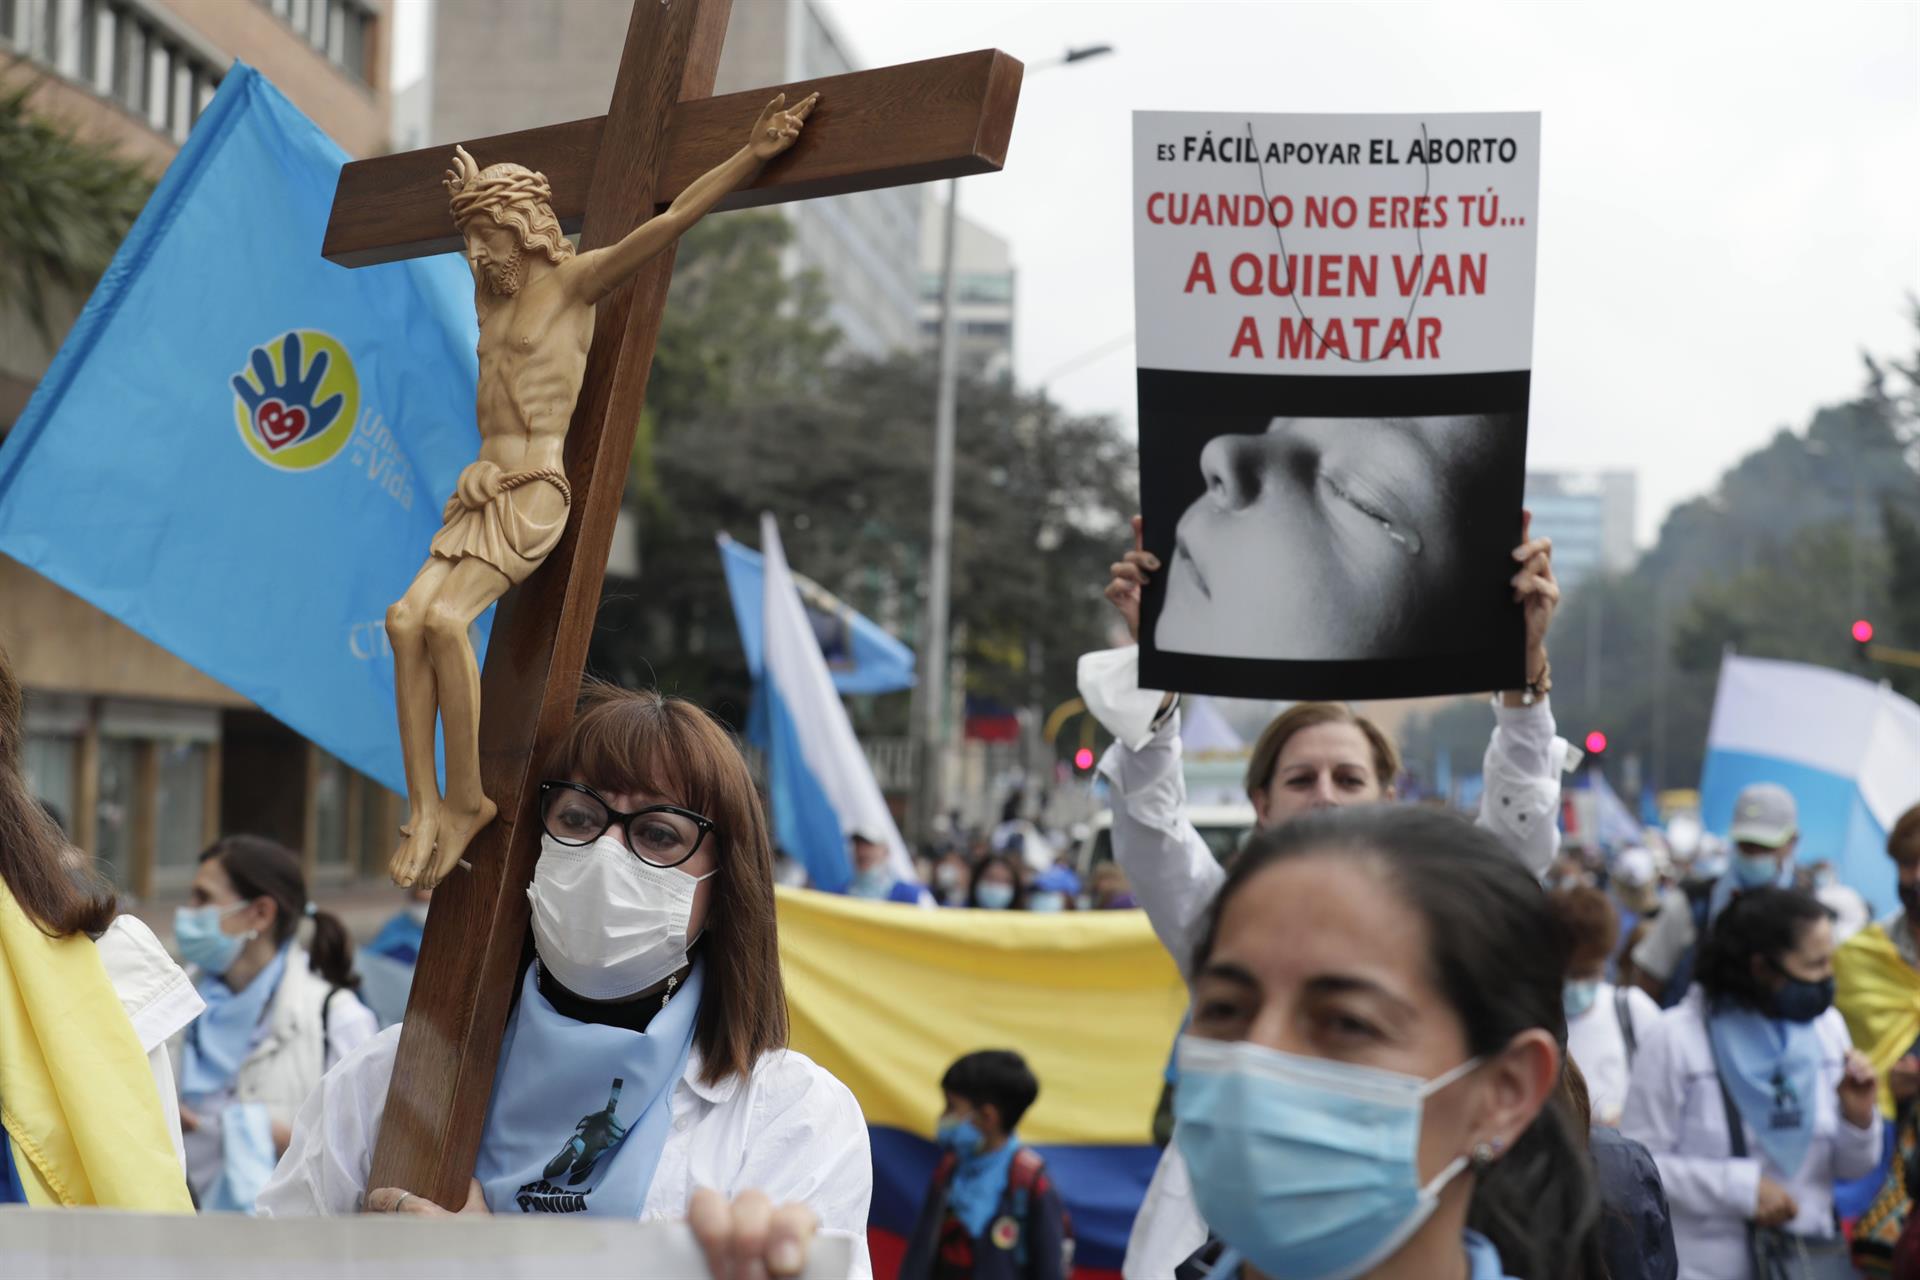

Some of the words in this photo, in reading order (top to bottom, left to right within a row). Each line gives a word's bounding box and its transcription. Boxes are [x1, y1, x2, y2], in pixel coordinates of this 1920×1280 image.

[1158, 144, 1175, 161] ES
[1184, 132, 1257, 163] FÁCIL
[1265, 143, 1360, 164] APOYAR
[1369, 140, 1398, 164] EL
[1407, 137, 1517, 164] ABORTO
[1147, 192, 1293, 226] CUANDO
[1305, 196, 1357, 228] NO
[1369, 196, 1448, 228] ERES
[1458, 188, 1525, 226] TÚ...
[1184, 252, 1216, 293] A
[1230, 253, 1378, 297] QUIEN
[1393, 253, 1487, 297] VAN
[1230, 317, 1264, 358] A
[1277, 317, 1442, 359] MATAR
[367, 447, 414, 512] Vida
